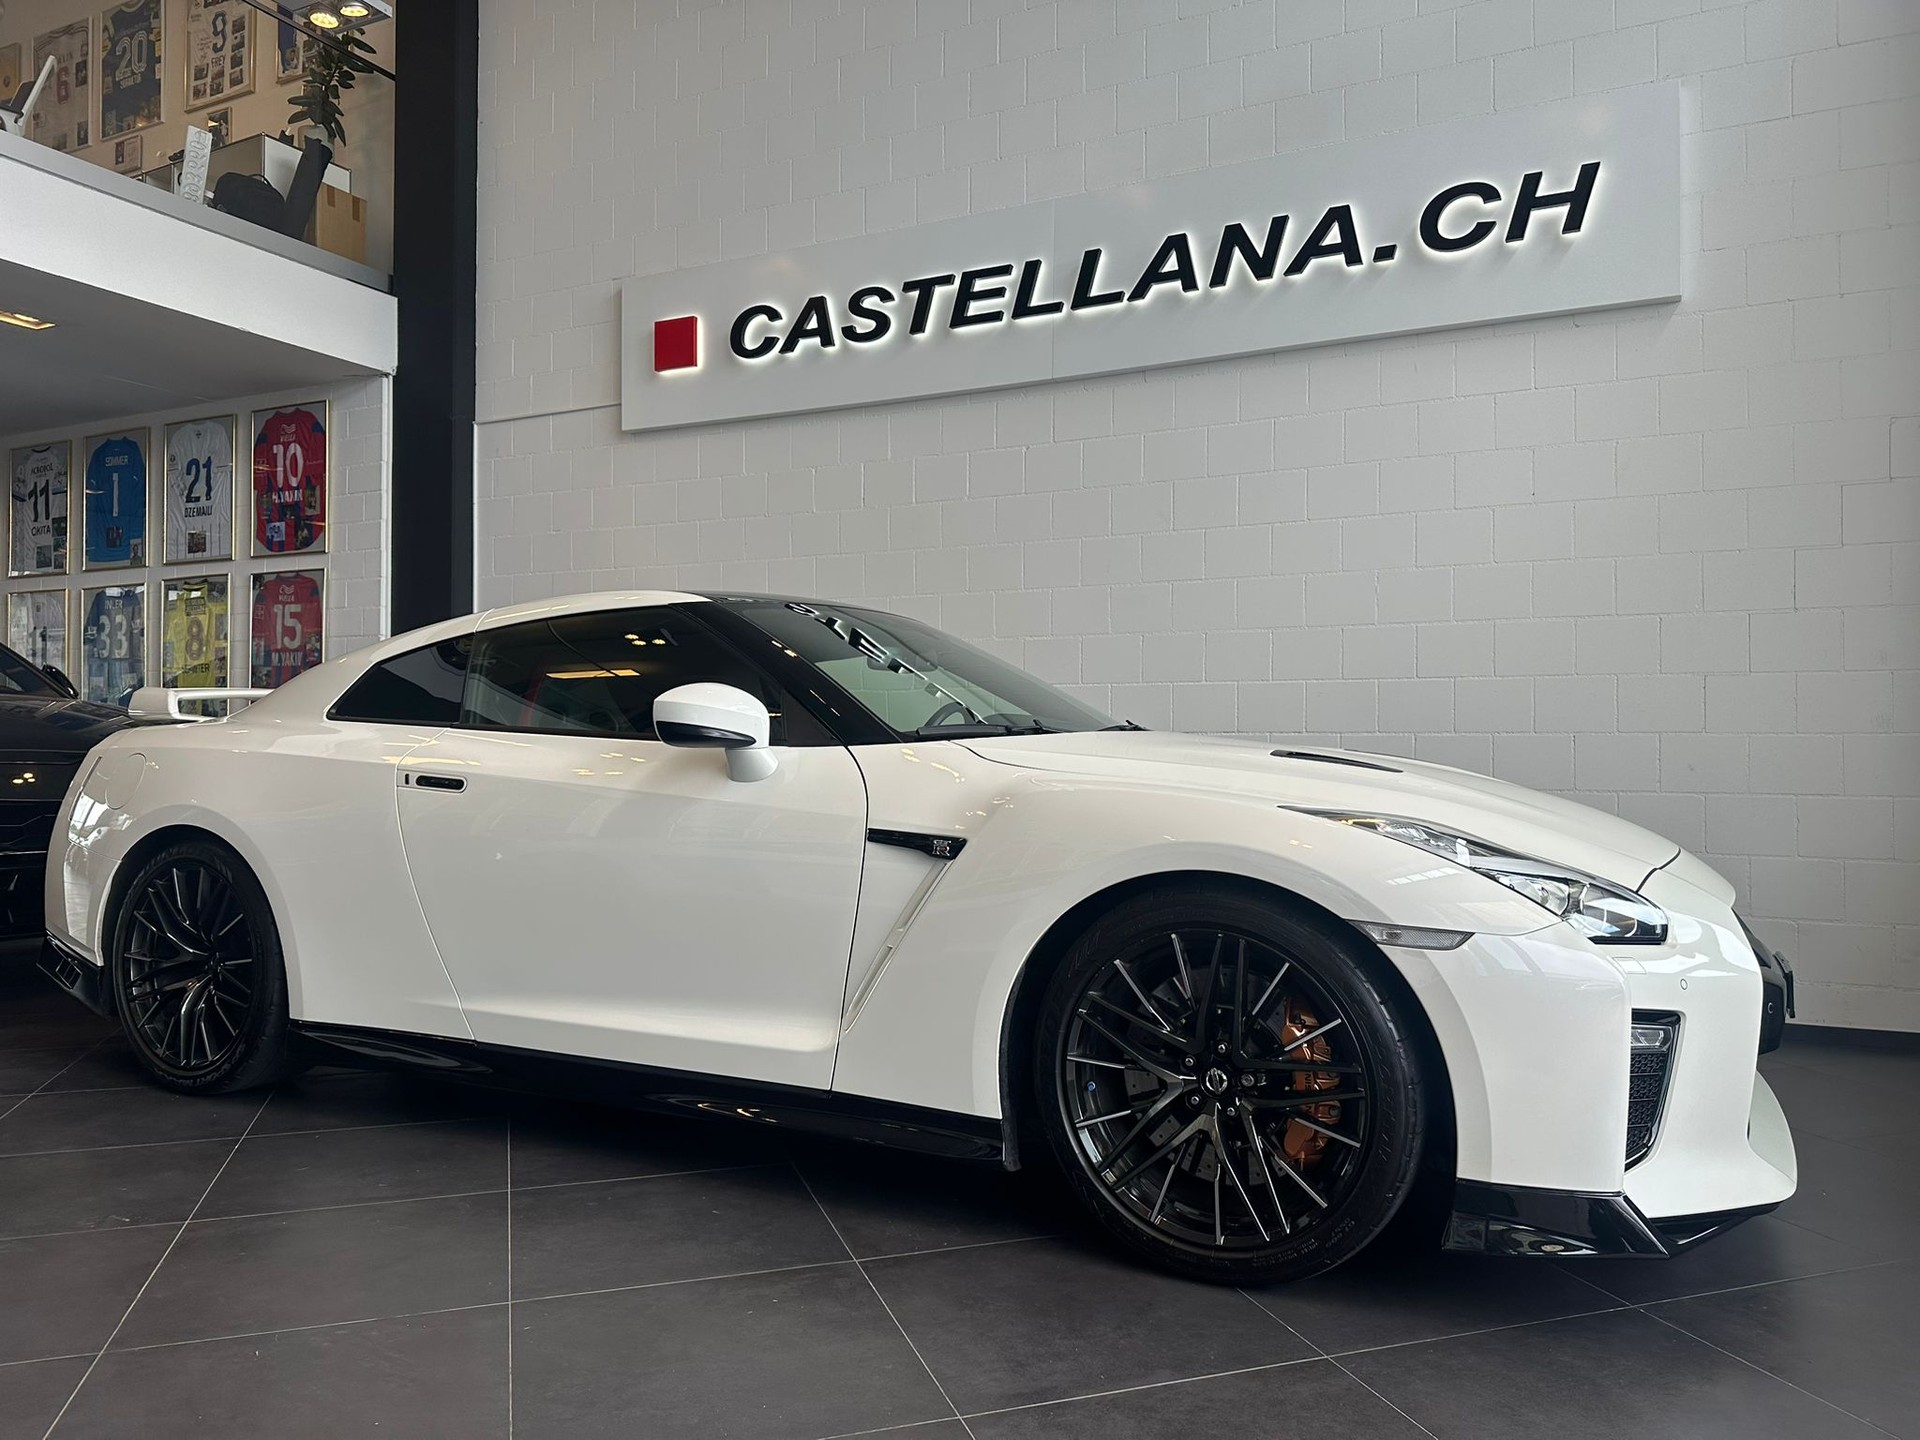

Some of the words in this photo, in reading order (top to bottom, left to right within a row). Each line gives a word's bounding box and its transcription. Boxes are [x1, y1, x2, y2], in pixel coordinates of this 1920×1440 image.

[211, 10, 227, 53] 9
[115, 30, 148, 81] 20
[729, 160, 1600, 360] CASTELLANA.CH
[105, 455, 128, 467] SOMMER
[185, 455, 213, 504] 21
[272, 442, 304, 488] 10
[27, 479, 51, 523] 11
[113, 472, 119, 518] 1
[31, 525, 52, 537] OKITA
[98, 614, 129, 659] 33
[185, 616, 204, 661] 8
[273, 603, 302, 650] 15
